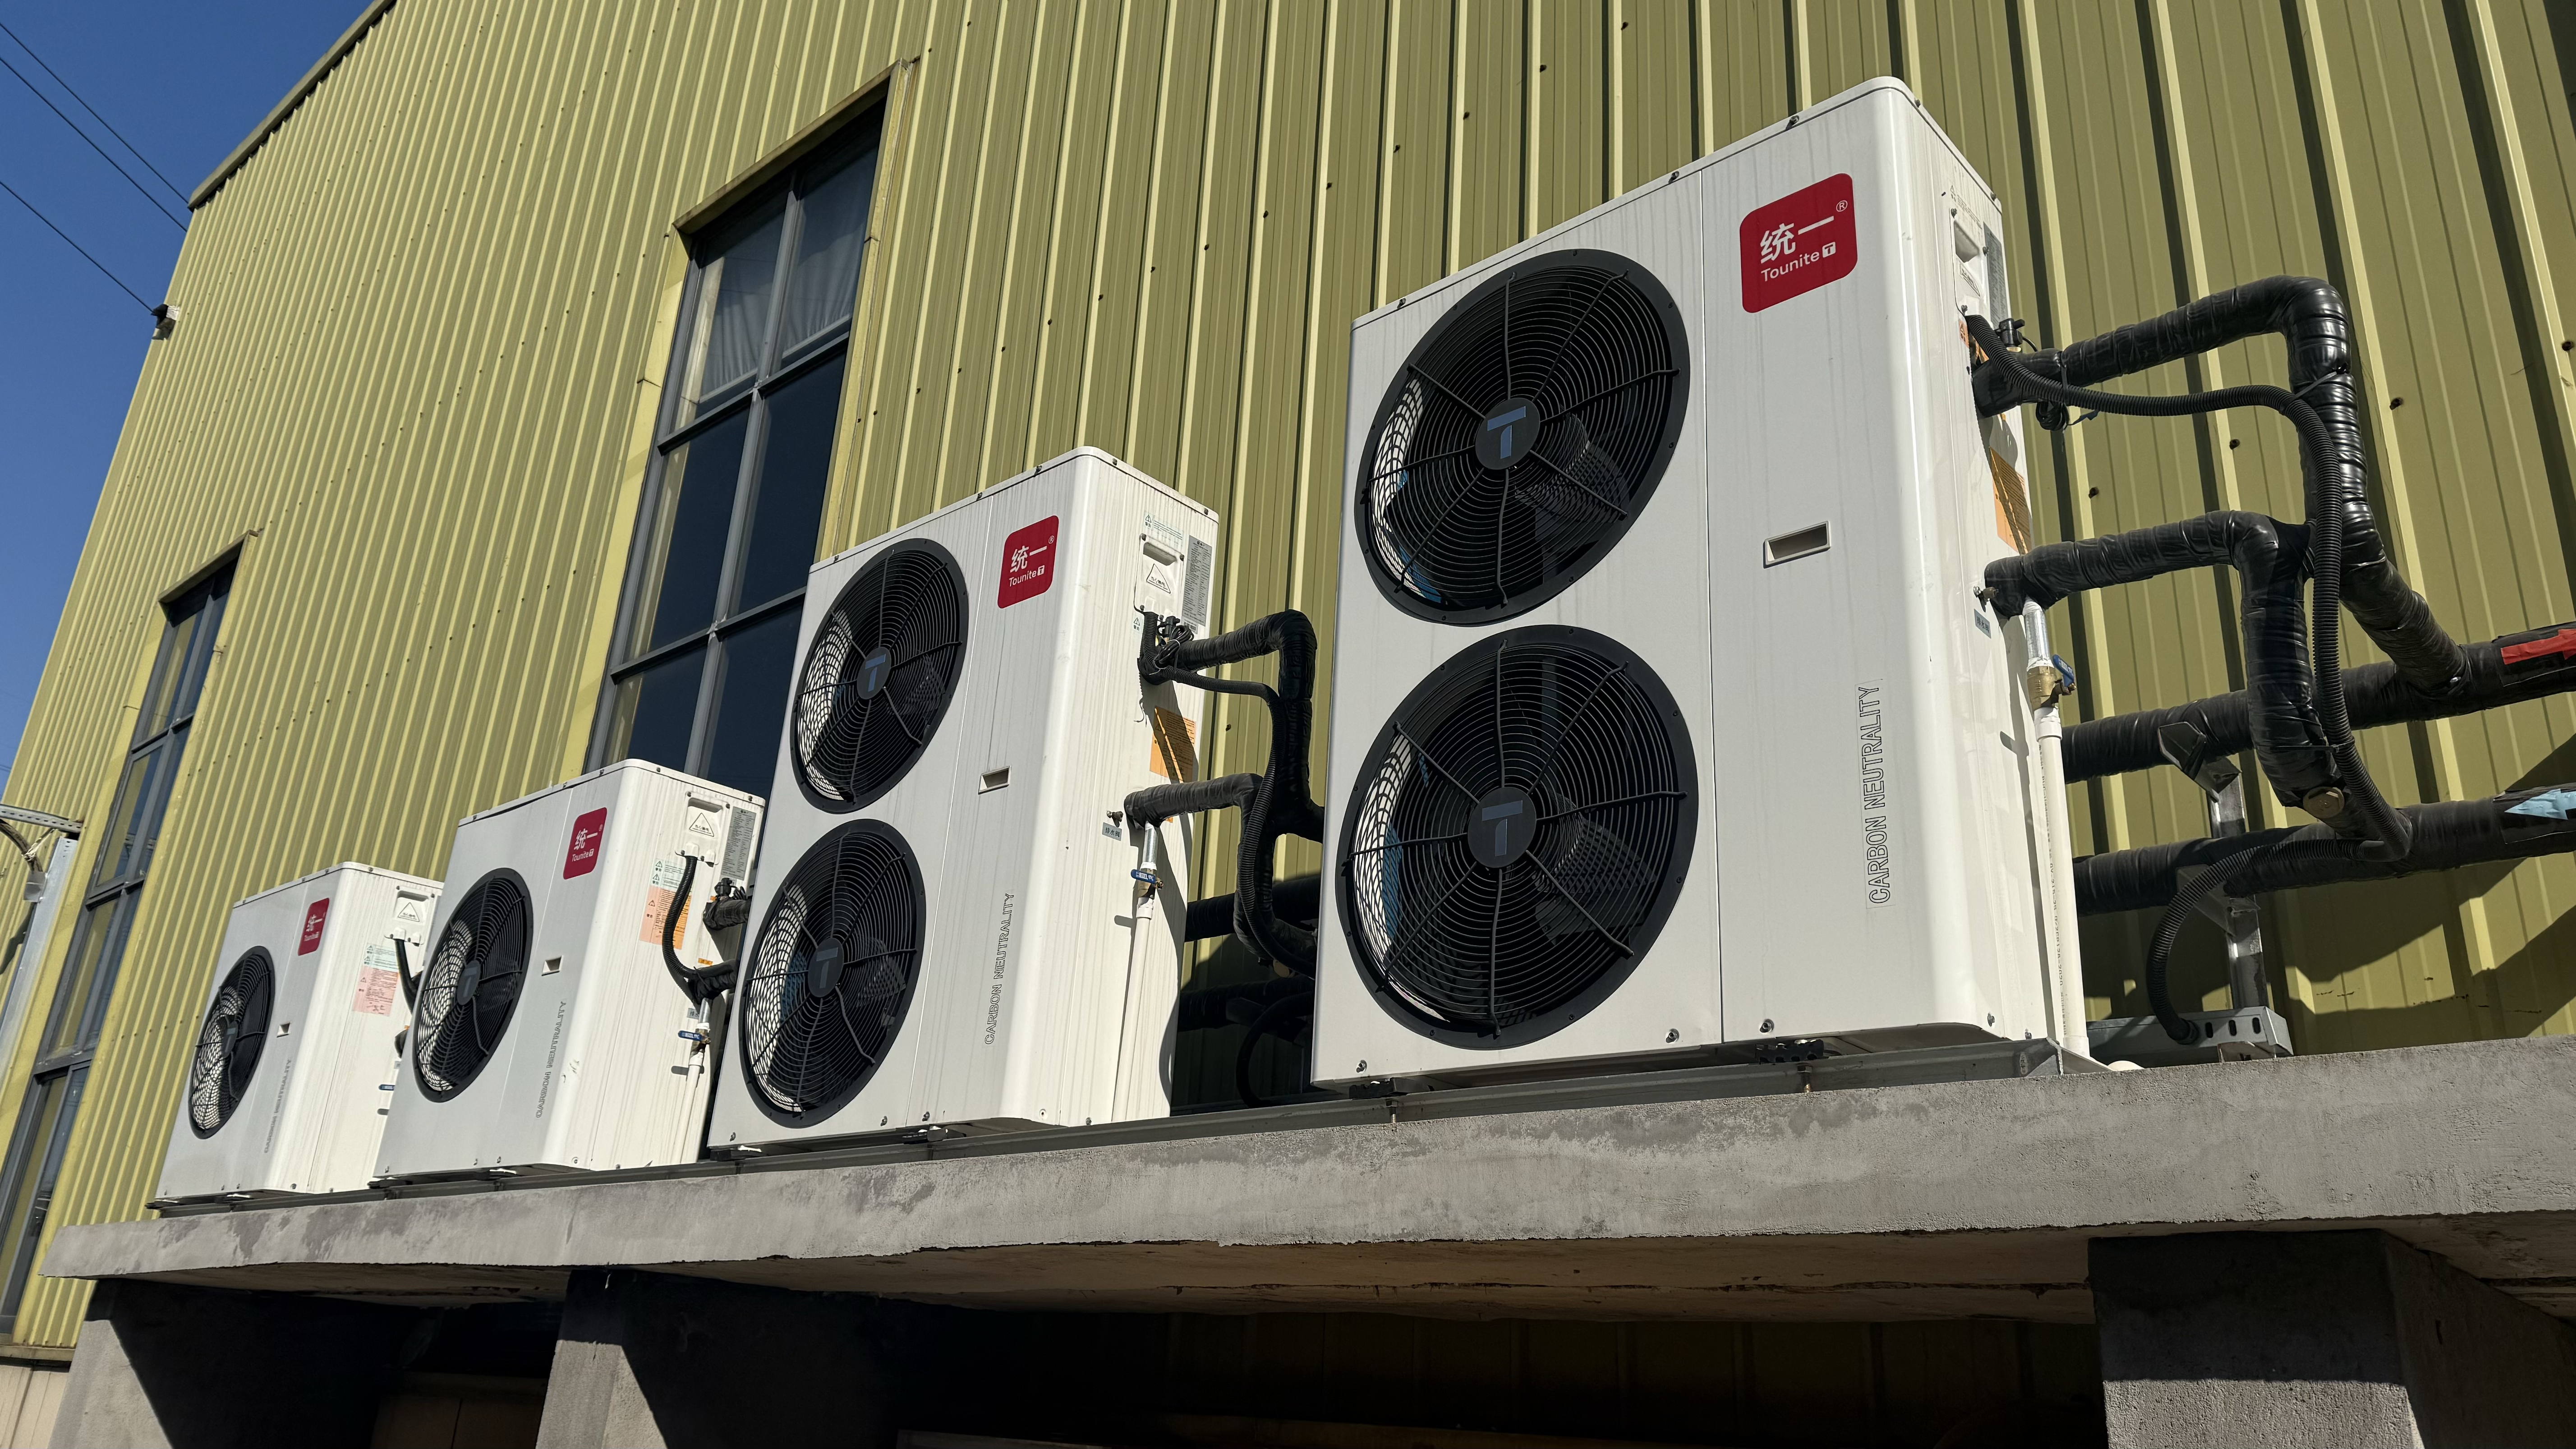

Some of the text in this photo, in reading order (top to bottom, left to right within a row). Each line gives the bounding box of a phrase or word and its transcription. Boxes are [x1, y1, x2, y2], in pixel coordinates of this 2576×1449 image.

[1760, 215, 1835, 264] 统一
[1761, 251, 1820, 282] Tounite
[1010, 545, 1047, 573] 统一
[1008, 570, 1037, 587] Tounite
[1858, 687, 1891, 904] CARBON NEUTRALITY
[574, 828, 598, 850] 统一
[984, 893, 1014, 1045] CARBON NEUTRALITY
